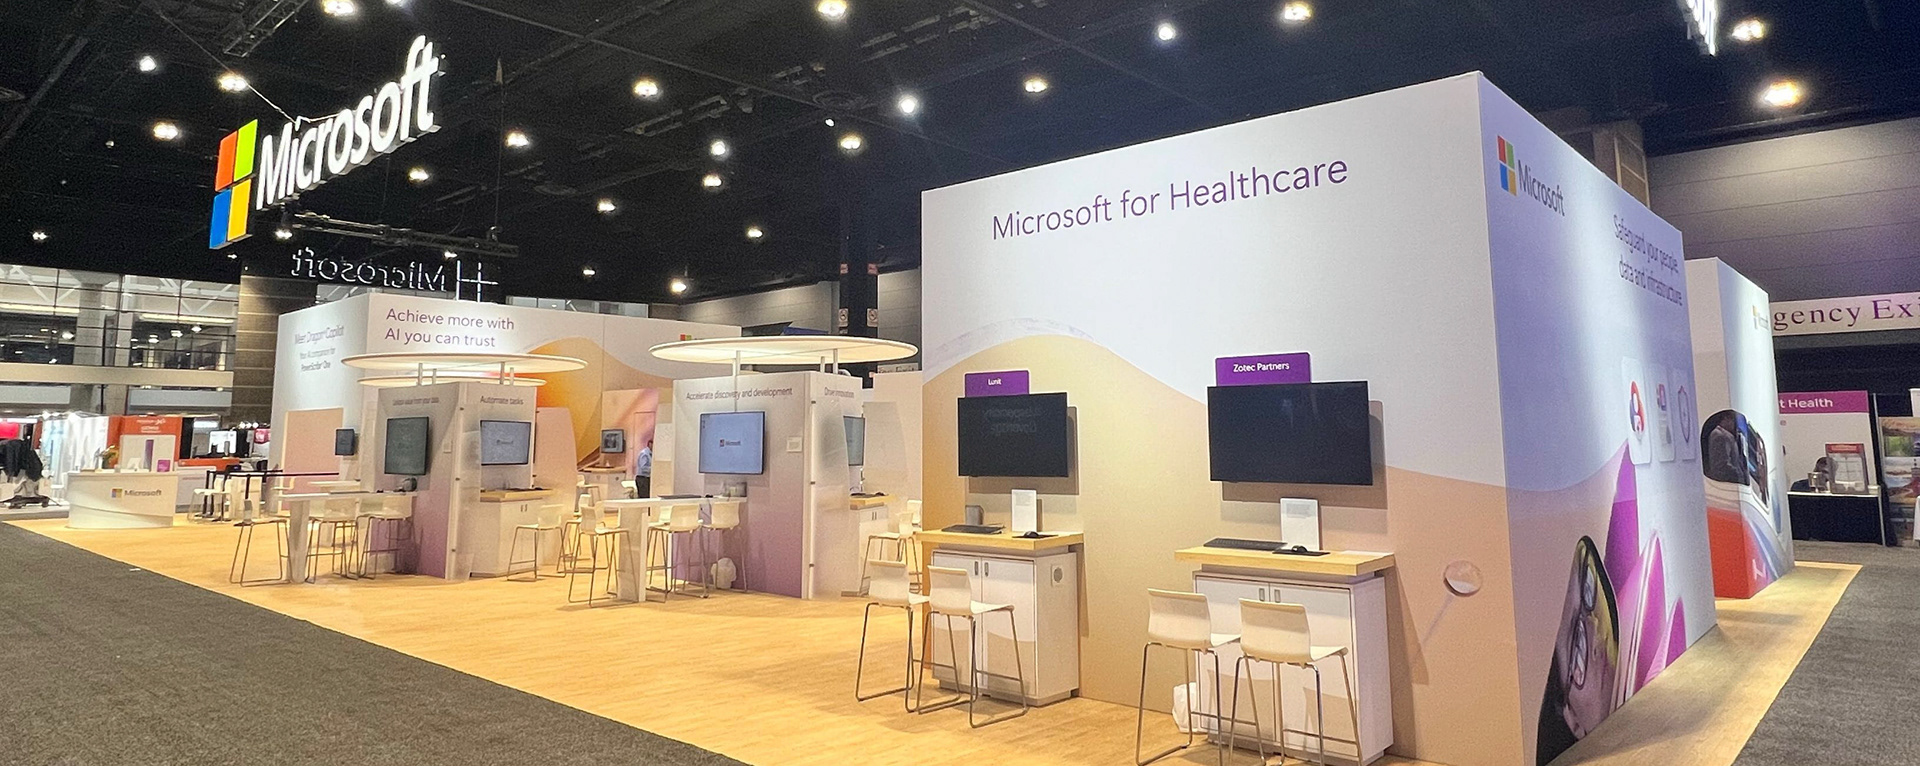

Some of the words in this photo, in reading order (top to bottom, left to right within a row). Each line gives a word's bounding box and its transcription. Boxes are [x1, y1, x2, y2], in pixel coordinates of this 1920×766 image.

[256, 34, 438, 210] Microsoft
[1518, 159, 1565, 216] Microsoft
[992, 194, 1112, 240] Microsoft
[1120, 190, 1160, 218] for
[1169, 159, 1349, 210] Healthcare
[1619, 254, 1634, 283] data
[1633, 265, 1646, 289] and
[1872, 297, 1920, 319] Ex
[386, 308, 444, 325] Achieve
[447, 316, 484, 328] more
[486, 317, 515, 330] with
[385, 328, 400, 341] AI
[404, 331, 431, 346] you
[435, 334, 460, 345] can
[464, 335, 496, 348] trust
[1233, 364, 1256, 373] Zotec
[1257, 362, 1290, 372] Partners
[480, 395, 509, 405] Automate
[686, 391, 714, 401] Accelerate
[714, 389, 741, 401] discovery
[740, 387, 753, 399] and
[752, 386, 793, 398] development
[1788, 398, 1834, 409] Health
[124, 488, 162, 498] Microsoft
